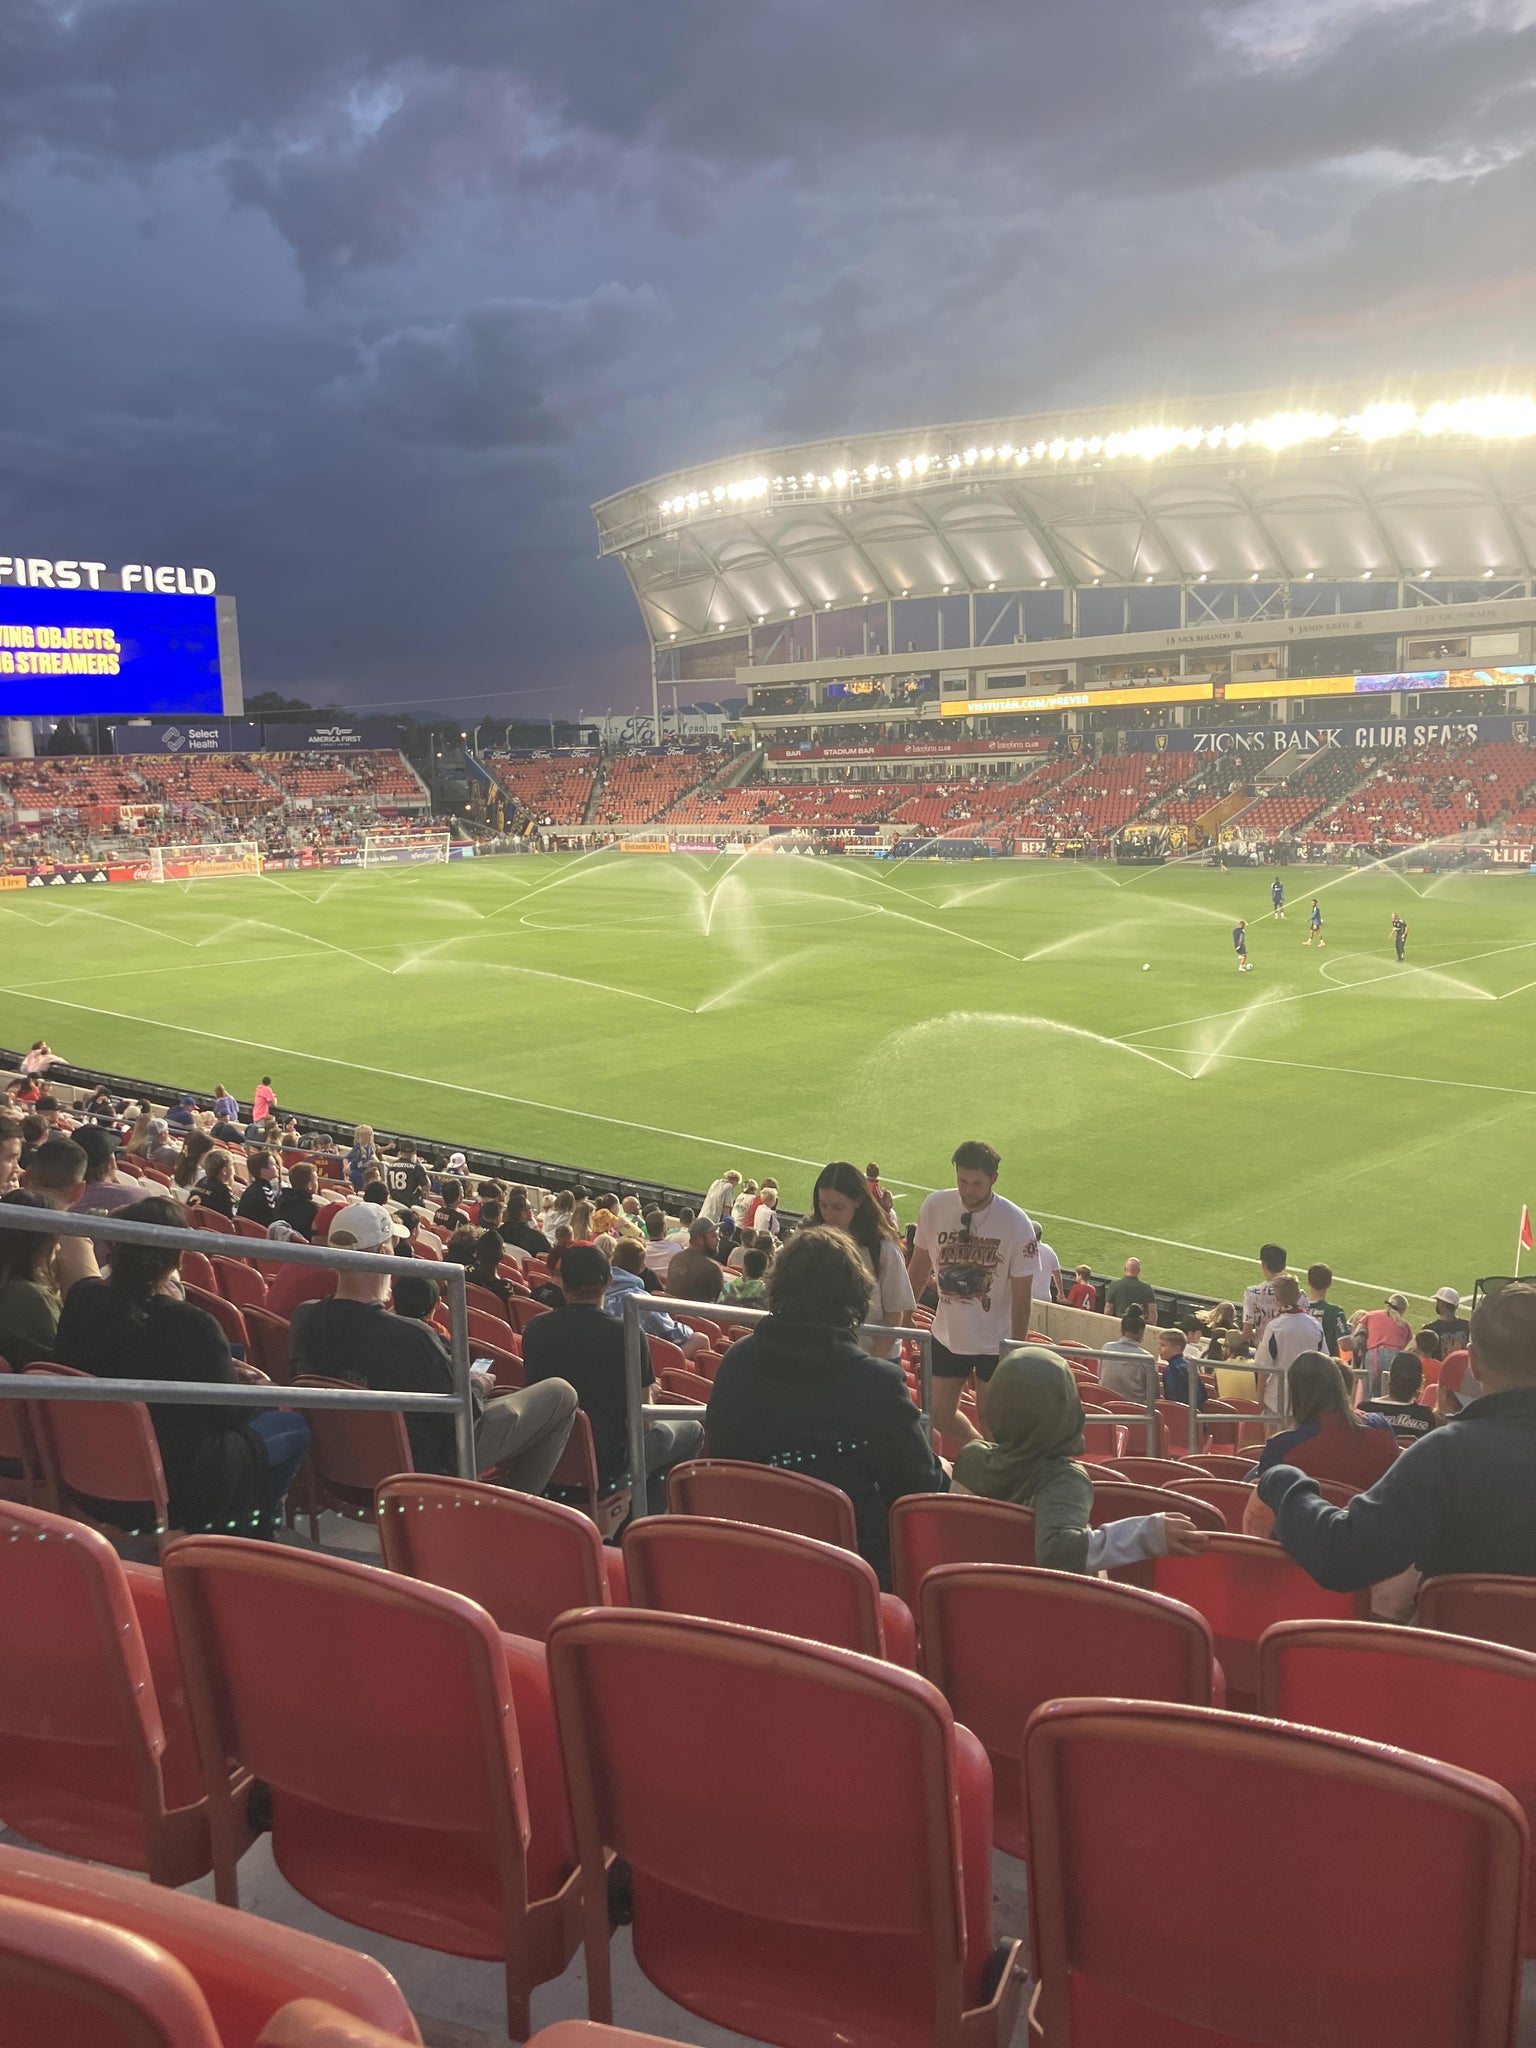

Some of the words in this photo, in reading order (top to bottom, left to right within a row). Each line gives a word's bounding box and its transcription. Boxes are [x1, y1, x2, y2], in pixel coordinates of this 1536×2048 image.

[0, 557, 107, 590] FIRST
[121, 564, 217, 595] FIELD
[1288, 625, 1294, 634] 9
[1299, 624, 1324, 634] JASON
[36, 626, 121, 653] OBJECTS,
[1166, 636, 1175, 645] 18
[1177, 635, 1195, 643] NICK
[15, 653, 120, 675] STREAMERS
[188, 729, 219, 739] Select
[308, 735, 341, 743] AMERICA
[341, 735, 362, 743] FIRST
[1193, 731, 1265, 752] ZIONS
[1273, 728, 1343, 751] BANK
[1355, 725, 1406, 748] CLUB
[189, 739, 219, 749] Health
[491, 751, 511, 759] Ford
[531, 750, 551, 759] Ford
[571, 750, 591, 758] Ford
[666, 747, 685, 756] Ford
[823, 748, 857, 756] STADIUM
[833, 828, 856, 838] LAKE
[625, 843, 651, 851] Continental
[1, 878, 22, 887] Tire
[389, 1170, 407, 1190] 18
[940, 1246, 1000, 1266] REAL
[1082, 1293, 1091, 1310] 4
